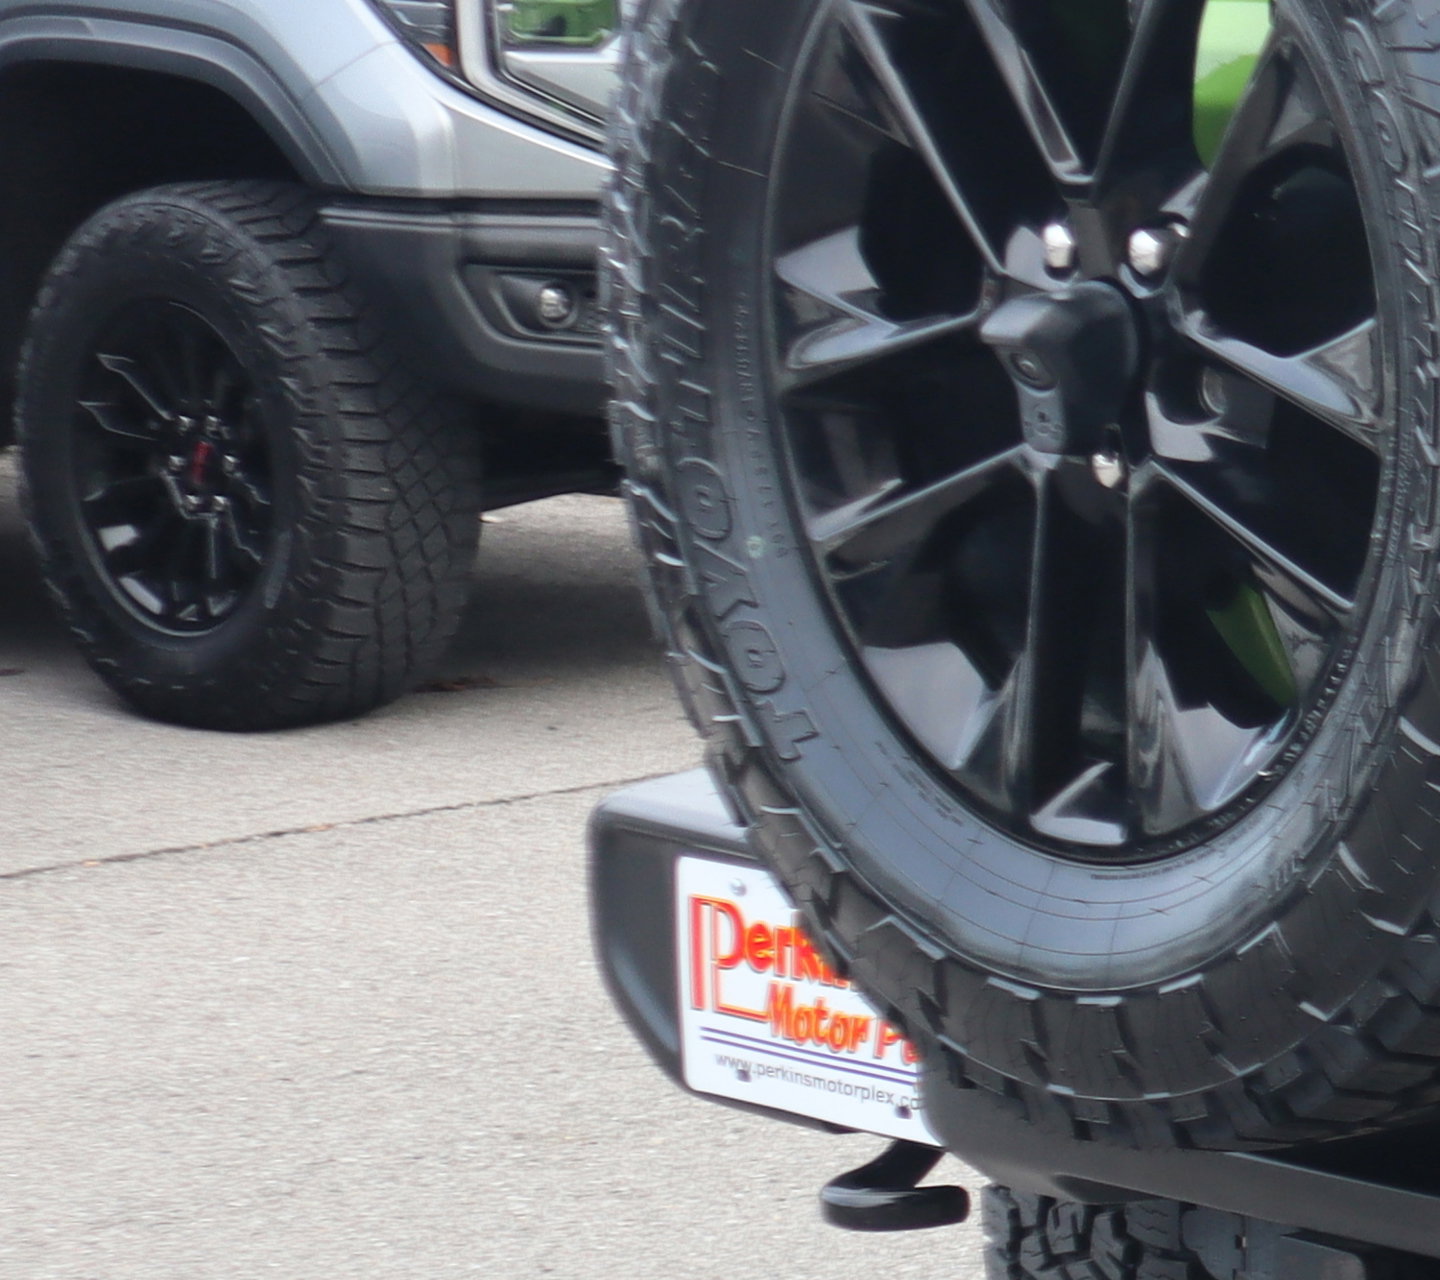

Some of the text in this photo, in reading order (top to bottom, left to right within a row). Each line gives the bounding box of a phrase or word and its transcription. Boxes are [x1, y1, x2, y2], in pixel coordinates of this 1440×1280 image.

[678, 457, 819, 761] TOYO
[688, 894, 853, 1022] Perk
[767, 980, 874, 1053] Motor
[715, 1053, 924, 1111] www.perkinsmotorplex.co
